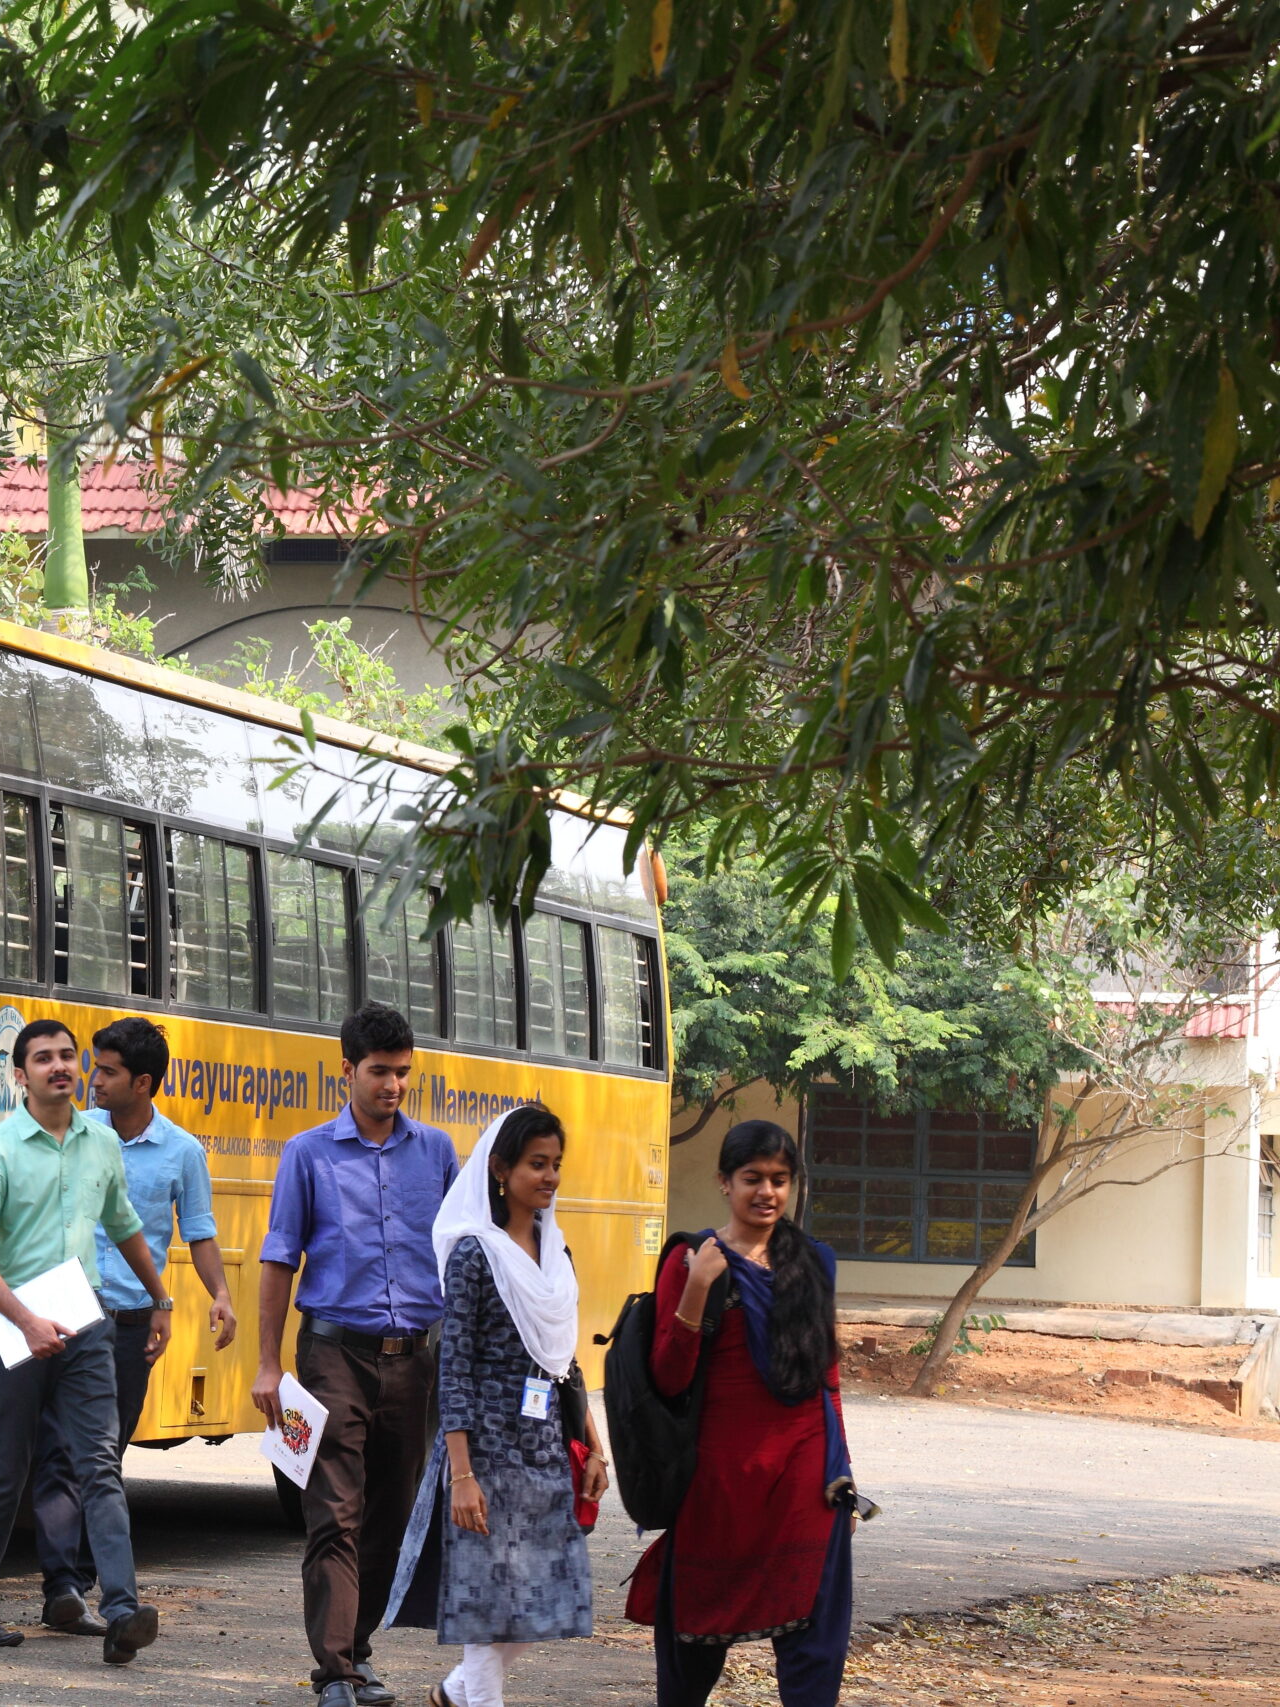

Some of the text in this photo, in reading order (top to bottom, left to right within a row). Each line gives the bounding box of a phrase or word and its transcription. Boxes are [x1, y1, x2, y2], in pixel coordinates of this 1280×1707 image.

[163, 1058, 308, 1119] uvayurappan
[407, 1072, 426, 1121] of
[431, 1075, 542, 1137] Managem
